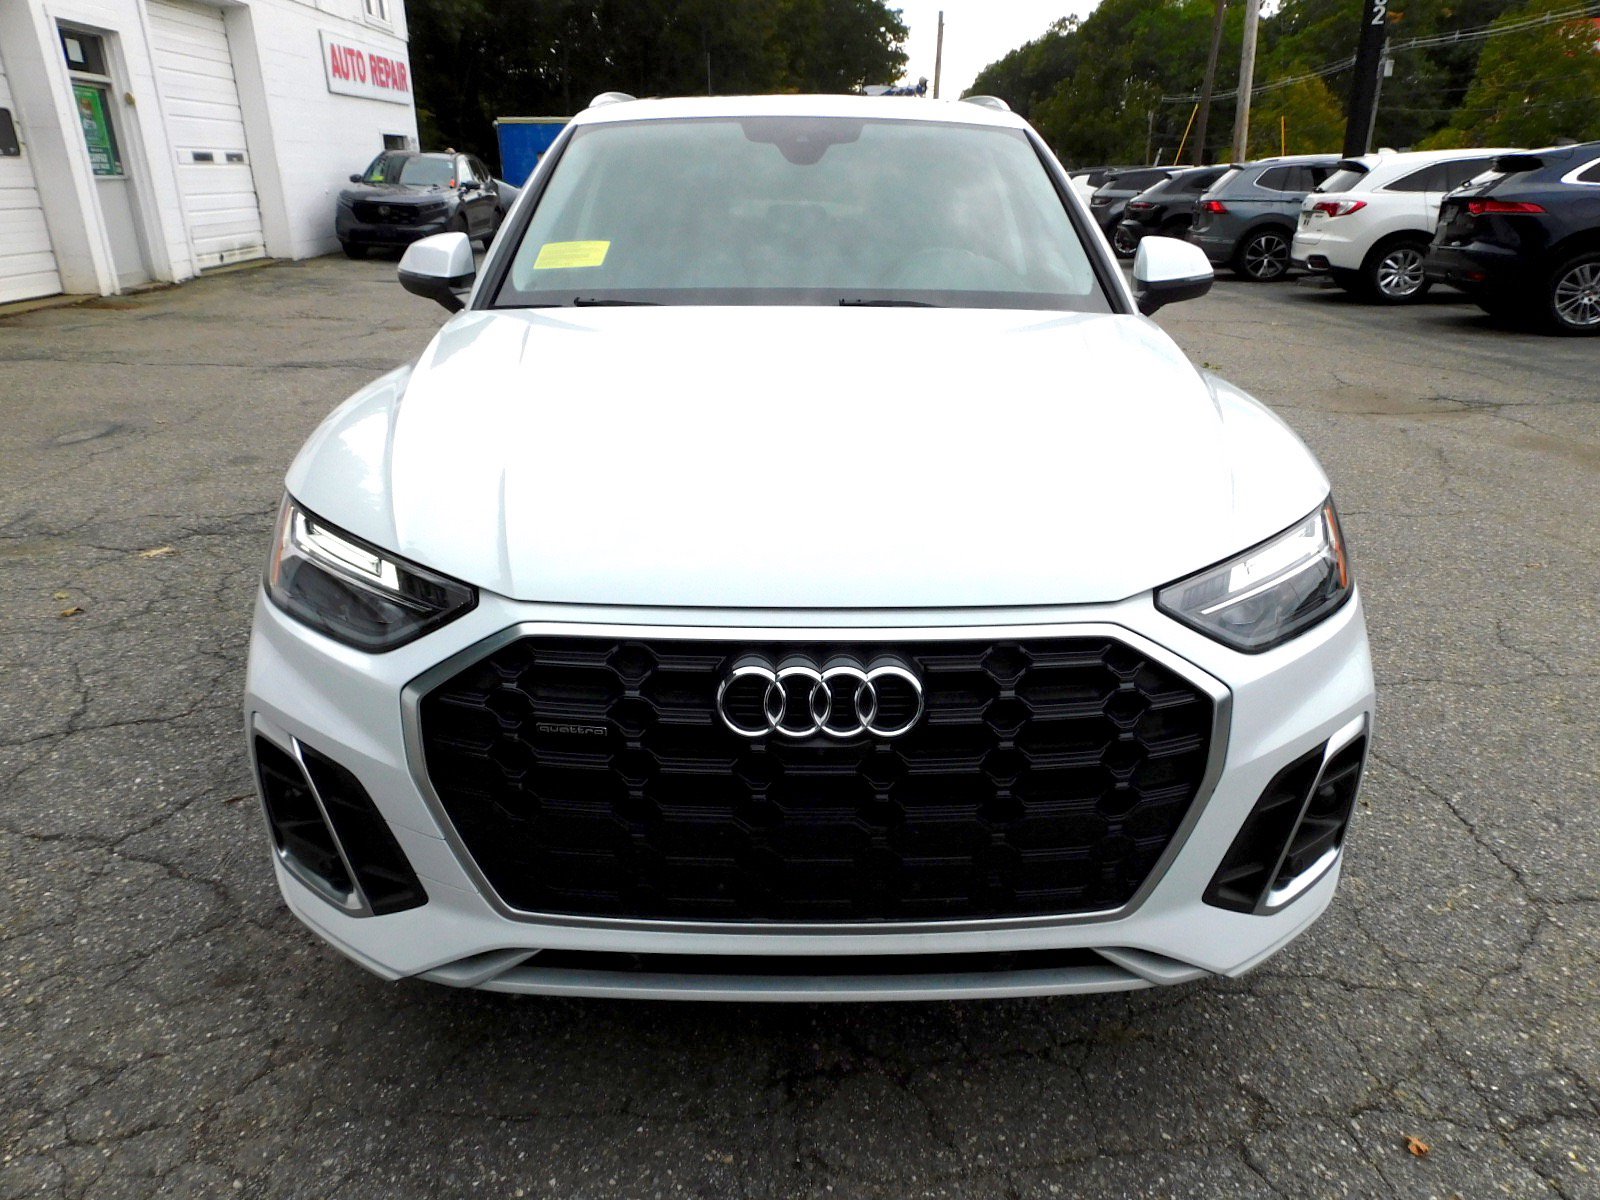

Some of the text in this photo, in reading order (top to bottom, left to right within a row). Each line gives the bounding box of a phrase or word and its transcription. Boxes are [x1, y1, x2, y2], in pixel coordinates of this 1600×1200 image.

[330, 42, 409, 92] AUTO REPAIR
[539, 725, 604, 735] quattro
